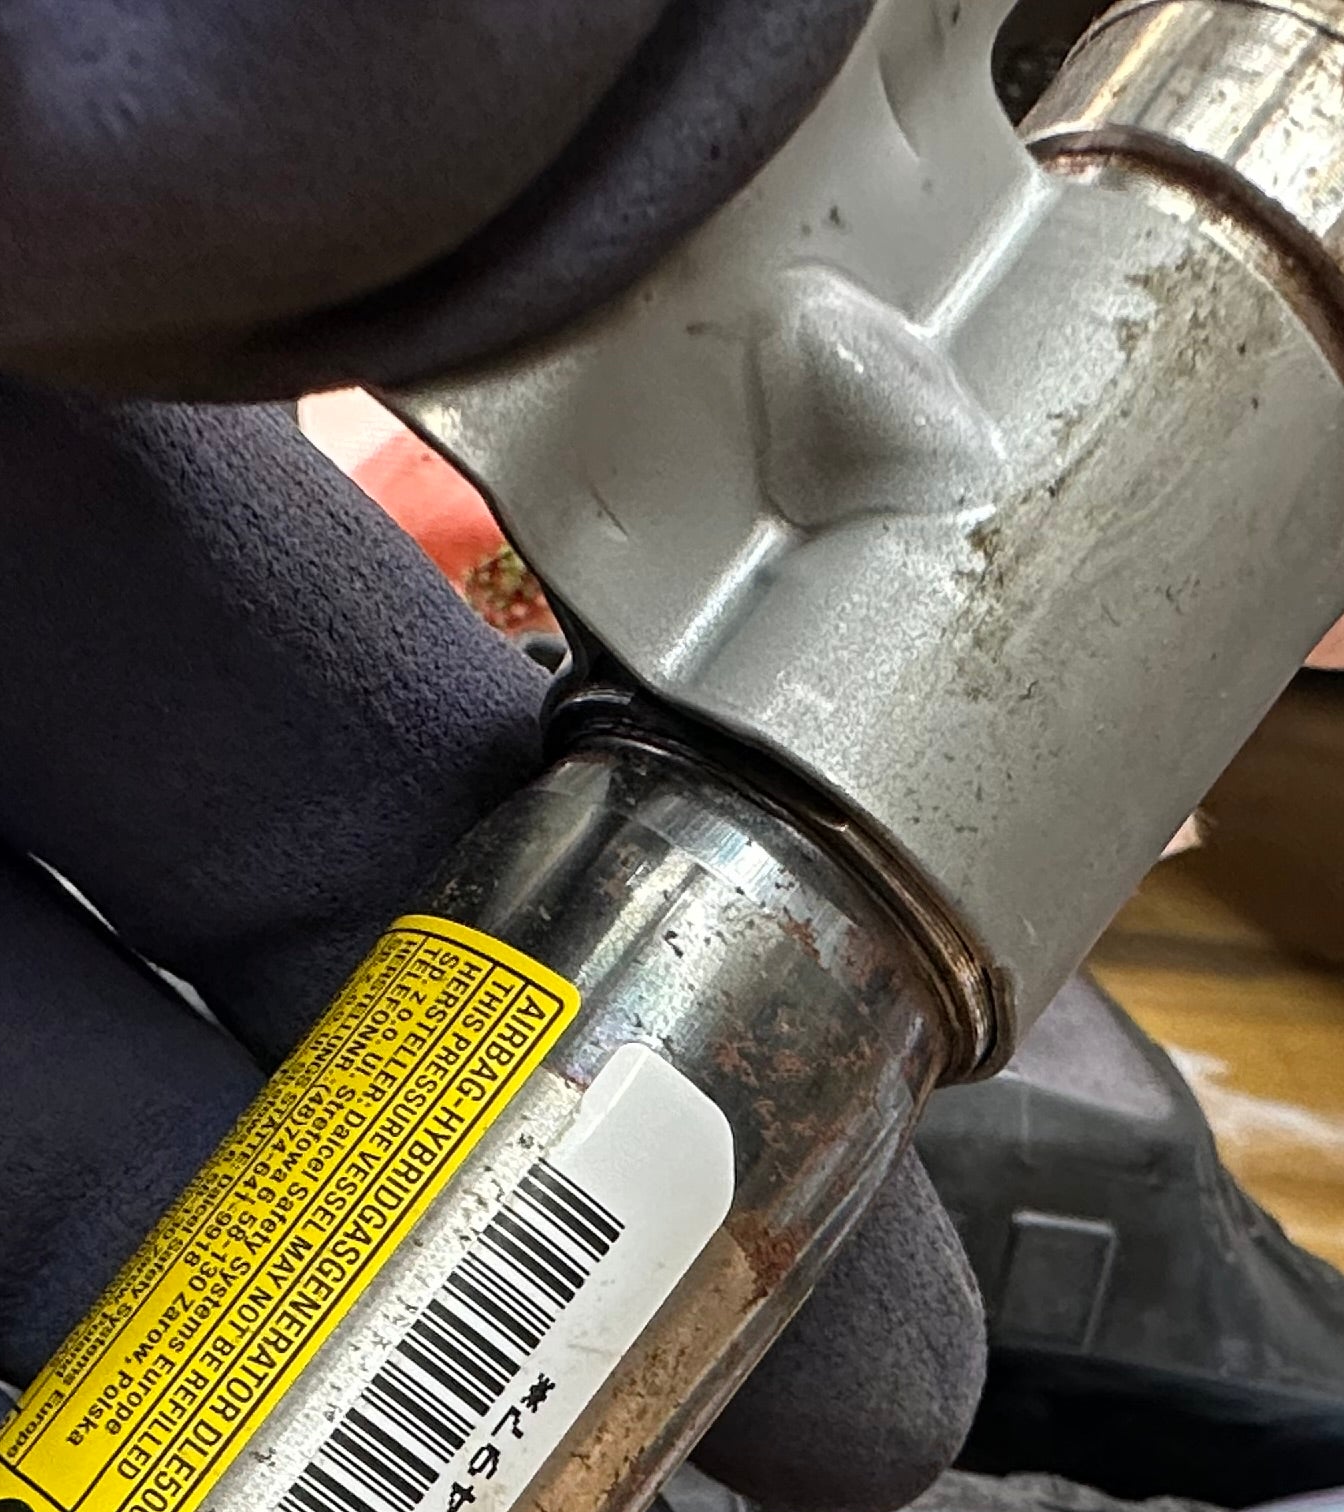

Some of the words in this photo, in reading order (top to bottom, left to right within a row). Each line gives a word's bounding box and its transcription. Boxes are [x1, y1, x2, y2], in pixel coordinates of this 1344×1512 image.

[354, 960, 483, 1111] HERSTELLER:
[459, 978, 515, 1035] THIS
[368, 1029, 472, 1153] PRESSURE
[300, 1107, 366, 1183] Daicel
[207, 993, 546, 1425] AIRBAG-HYBRIDGASGENERATOR
[242, 1178, 310, 1259] Safety
[300, 1148, 382, 1236] VESSEL
[185, 1208, 259, 1294] 58-130
[264, 1233, 313, 1290] MAY
[123, 1289, 195, 1369] Zarow,
[164, 1253, 253, 1356] Systems
[225, 1285, 273, 1339] NOT
[197, 1333, 236, 1373] BE
[3, 1387, 66, 1459] Europe
[64, 1367, 135, 1450] Polska
[102, 1352, 177, 1439] Europe
[113, 1367, 210, 1483] REFILLED
